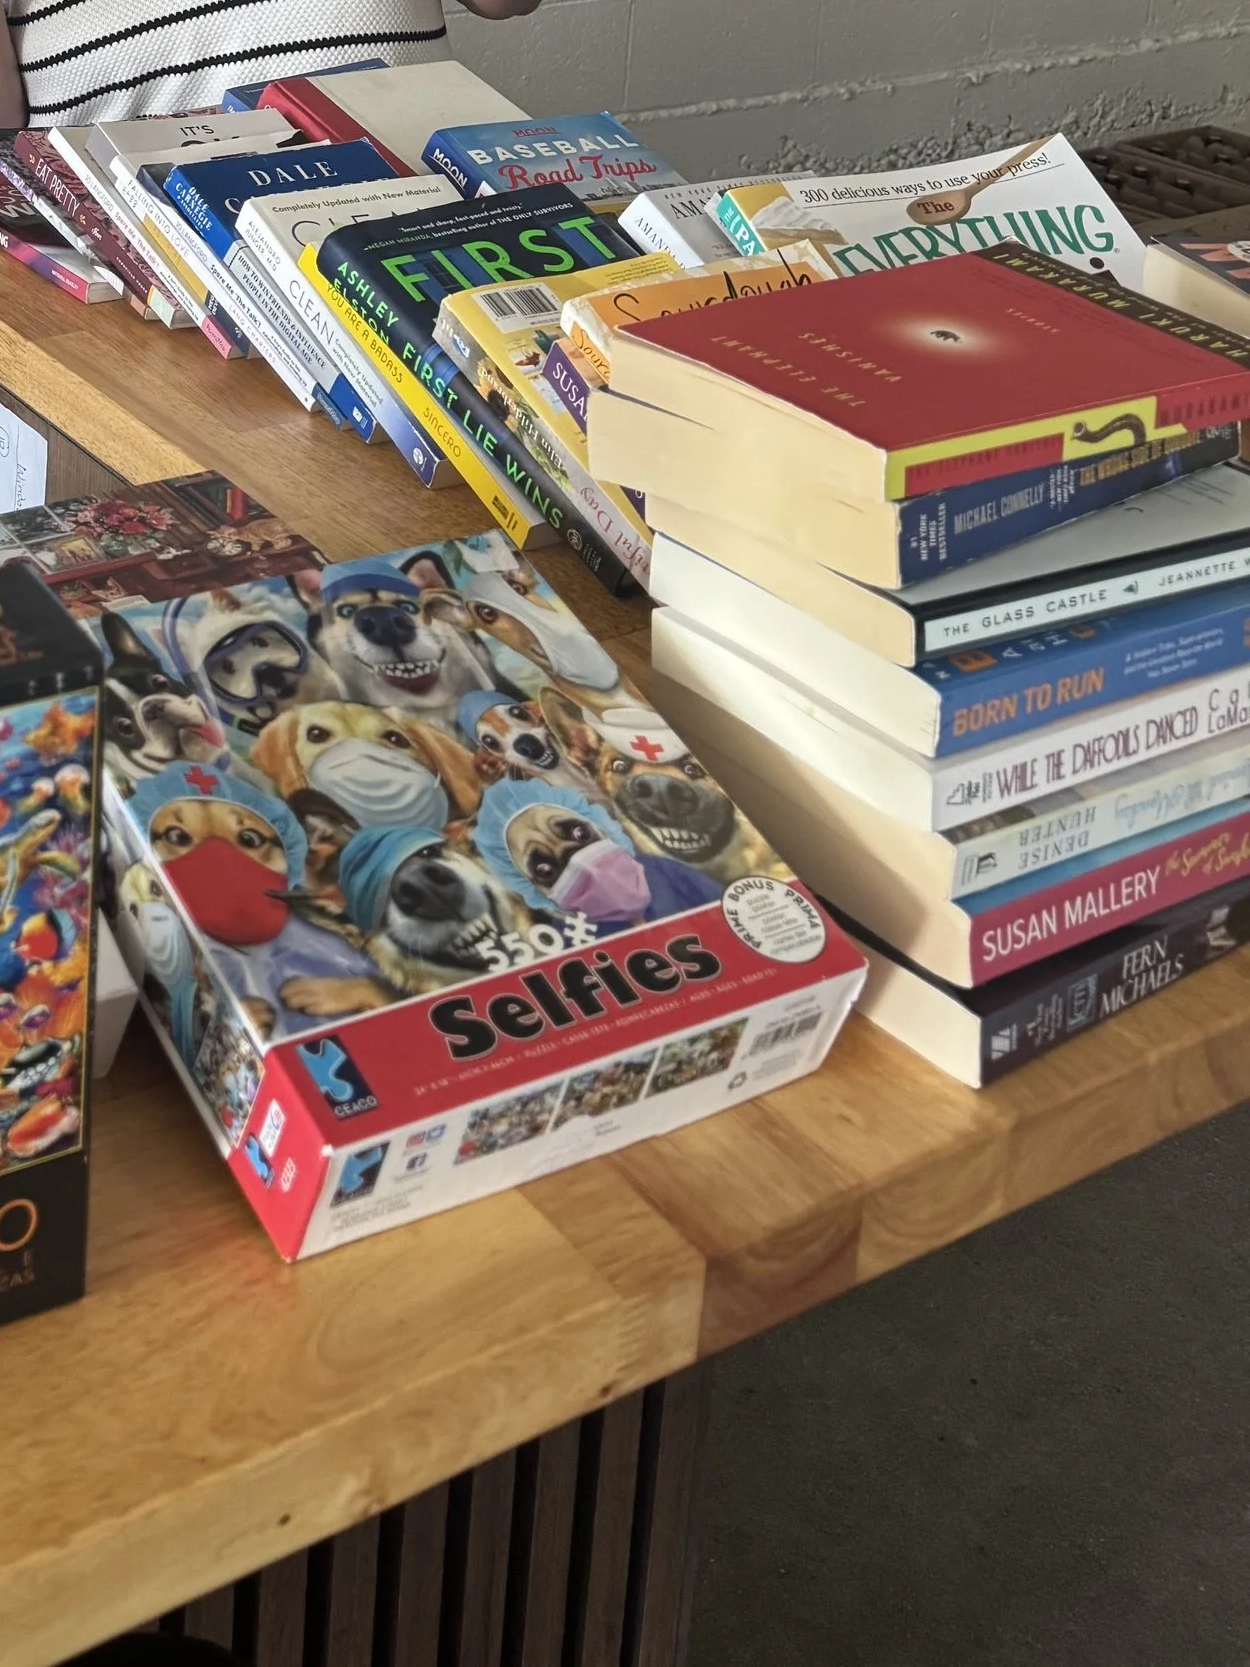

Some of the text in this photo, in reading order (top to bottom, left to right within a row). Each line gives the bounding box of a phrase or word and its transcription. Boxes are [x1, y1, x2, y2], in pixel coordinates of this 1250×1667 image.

[180, 124, 215, 137] IT'S
[466, 134, 639, 165] BASEBALL
[35, 158, 80, 217] EAT PRETTY
[248, 160, 339, 187] DALE
[433, 148, 468, 188] MOON
[497, 154, 658, 190] Road Trips
[800, 152, 1052, 204] 300 delicious ways to use your press!
[128, 179, 155, 215] FALLING
[154, 212, 172, 235] INTO
[170, 233, 190, 258] LOVE
[174, 182, 213, 232] CARNEGIE
[189, 186, 209, 214] DALE
[272, 186, 442, 213] Completely Updated with New Material
[496, 215, 511, 224] THE
[512, 210, 532, 221] ONLY
[533, 202, 574, 217] SURVIVORS
[723, 206, 735, 222] THE
[917, 198, 956, 216] The
[380, 216, 619, 303] FIRST
[833, 205, 1114, 277] EVERYTHING
[210, 263, 235, 295] Spare Me
[337, 261, 400, 328] ASHLEY
[993, 252, 1131, 309] MURAKAMI
[237, 255, 326, 370] HOW TO FRIENDS INFLUENCE
[266, 302, 314, 367] THE DIGITAL AGE
[289, 280, 335, 346] CLEAN
[1139, 313, 1249, 358] HARUKI
[326, 285, 462, 459] YOU ARE A BADASS SINCERO
[332, 348, 355, 379] with New
[335, 338, 384, 405] Completely Updated
[710, 336, 816, 382] ELEPHANT
[798, 333, 902, 383] VANISHES
[402, 341, 564, 530] FIRST LIE WINS
[481, 367, 615, 534] Day Elin Hilderbrand
[16, 463, 27, 510] Windo
[953, 500, 999, 535] MICHAEL
[1000, 483, 1046, 517] CONNELLY
[942, 559, 1236, 638] THE GLASS CASTLE JEANNETTE
[953, 669, 1104, 737] BORN TO RUN
[996, 705, 1199, 799] WHILE THE DAFFODILS DANCED
[1018, 830, 1090, 870] DENISE
[1019, 806, 1097, 847] HUNTER
[727, 878, 775, 902] BONUS
[784, 888, 822, 929] PRIMA
[982, 865, 1161, 962] SUSAN MALLERY
[477, 922, 565, 974] 550
[725, 906, 762, 949] PRIME
[1121, 934, 1168, 981] FERN
[428, 933, 722, 1062] Selfies
[1100, 953, 1185, 1018] MICHAELS
[333, 1095, 379, 1119] CEACO
